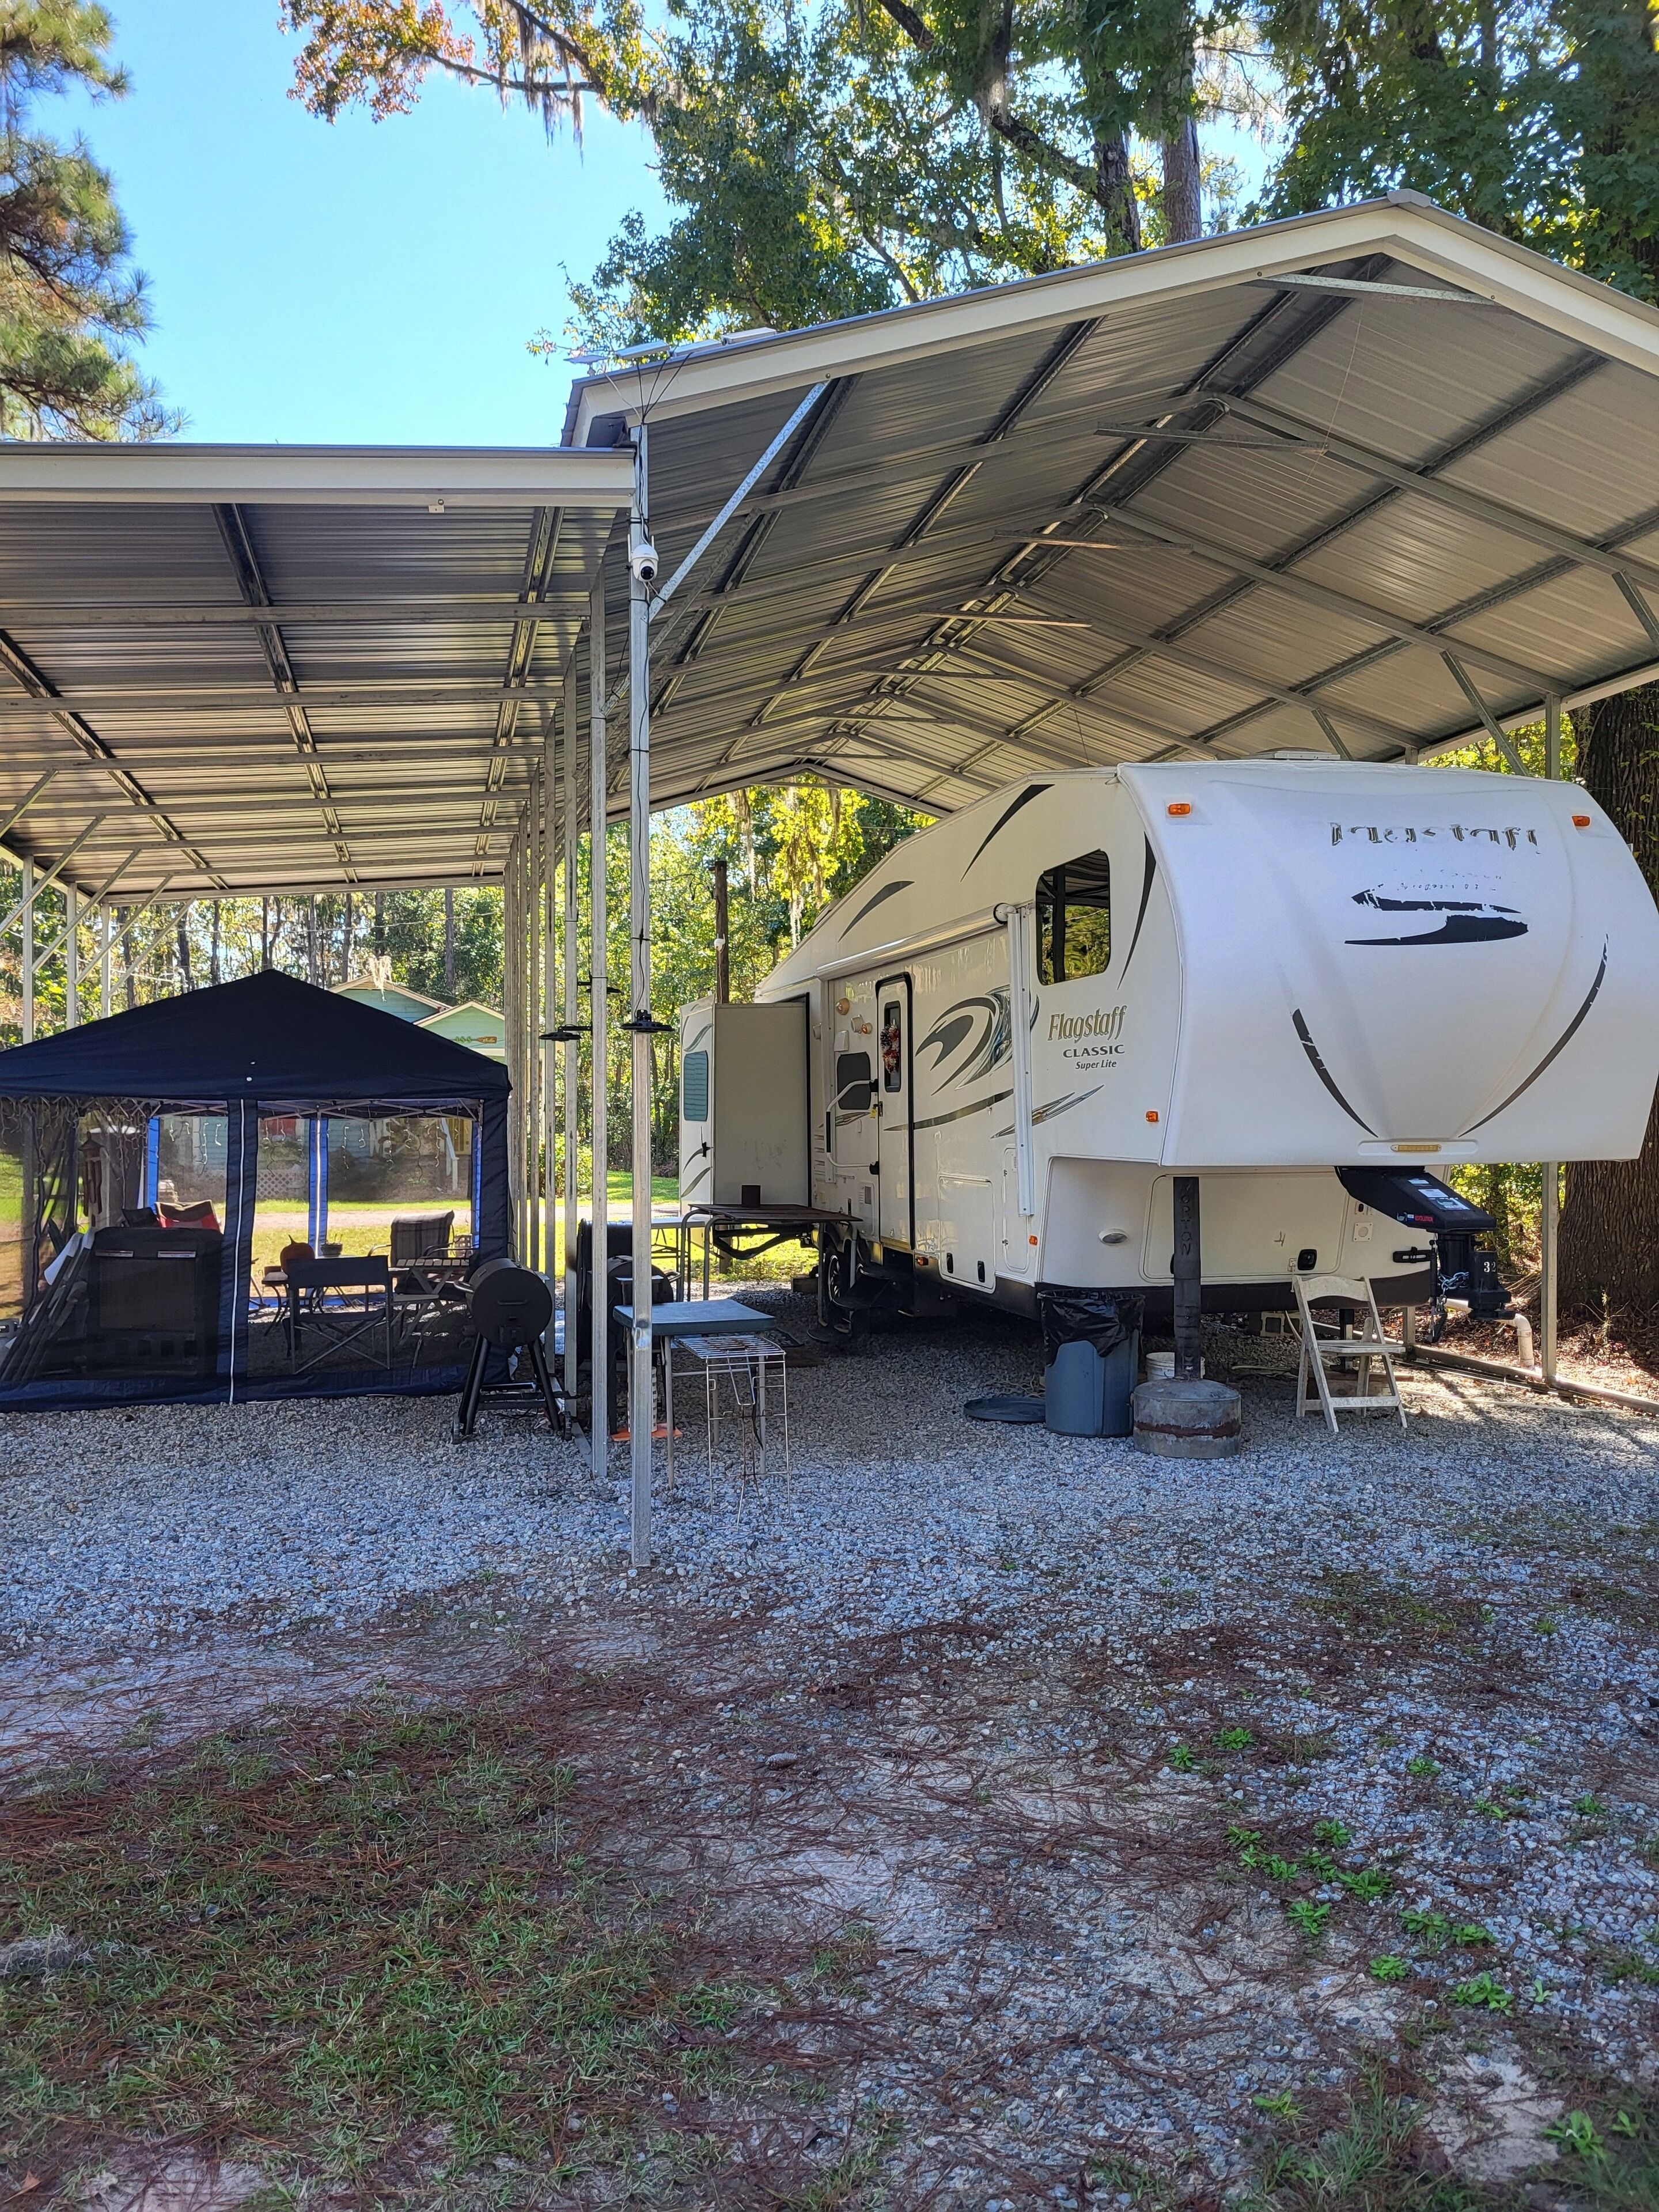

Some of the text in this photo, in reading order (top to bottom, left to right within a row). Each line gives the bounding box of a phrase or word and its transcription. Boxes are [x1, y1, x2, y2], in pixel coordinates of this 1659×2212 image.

[1047, 1005, 1127, 1043] Flagstaff
[1063, 1044, 1126, 1058] CLASSIC
[1075, 1059, 1117, 1071] Super Lite
[1483, 1261, 1497, 1272] 32
